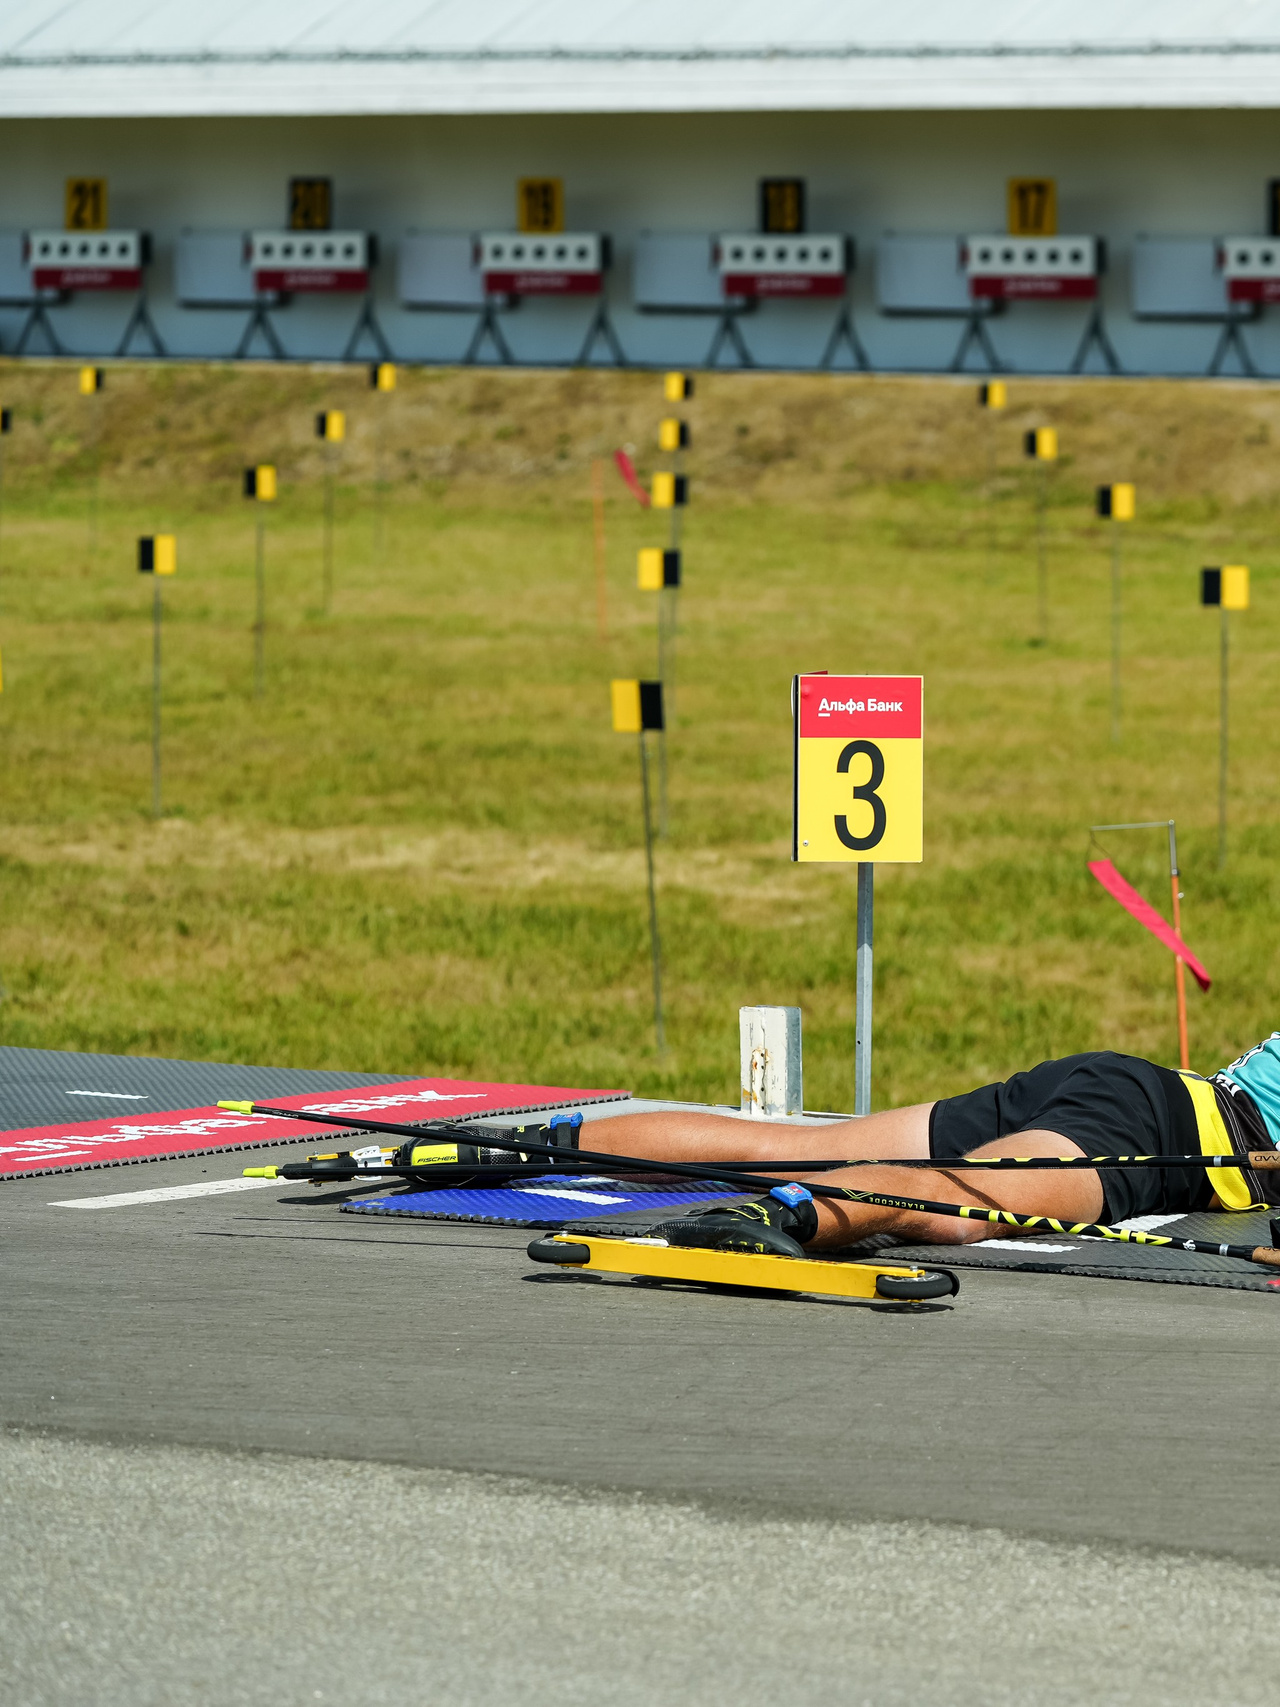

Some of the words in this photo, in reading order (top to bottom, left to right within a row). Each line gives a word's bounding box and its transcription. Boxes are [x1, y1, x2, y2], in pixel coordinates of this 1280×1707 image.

[72, 182, 103, 227] 21
[1016, 183, 1048, 231] 17
[818, 698, 865, 716] Альфа
[867, 698, 903, 712] Банк
[834, 739, 887, 851] 3
[417, 1155, 457, 1164] FISCHER
[869, 1196, 925, 1211] BLACKCODE
